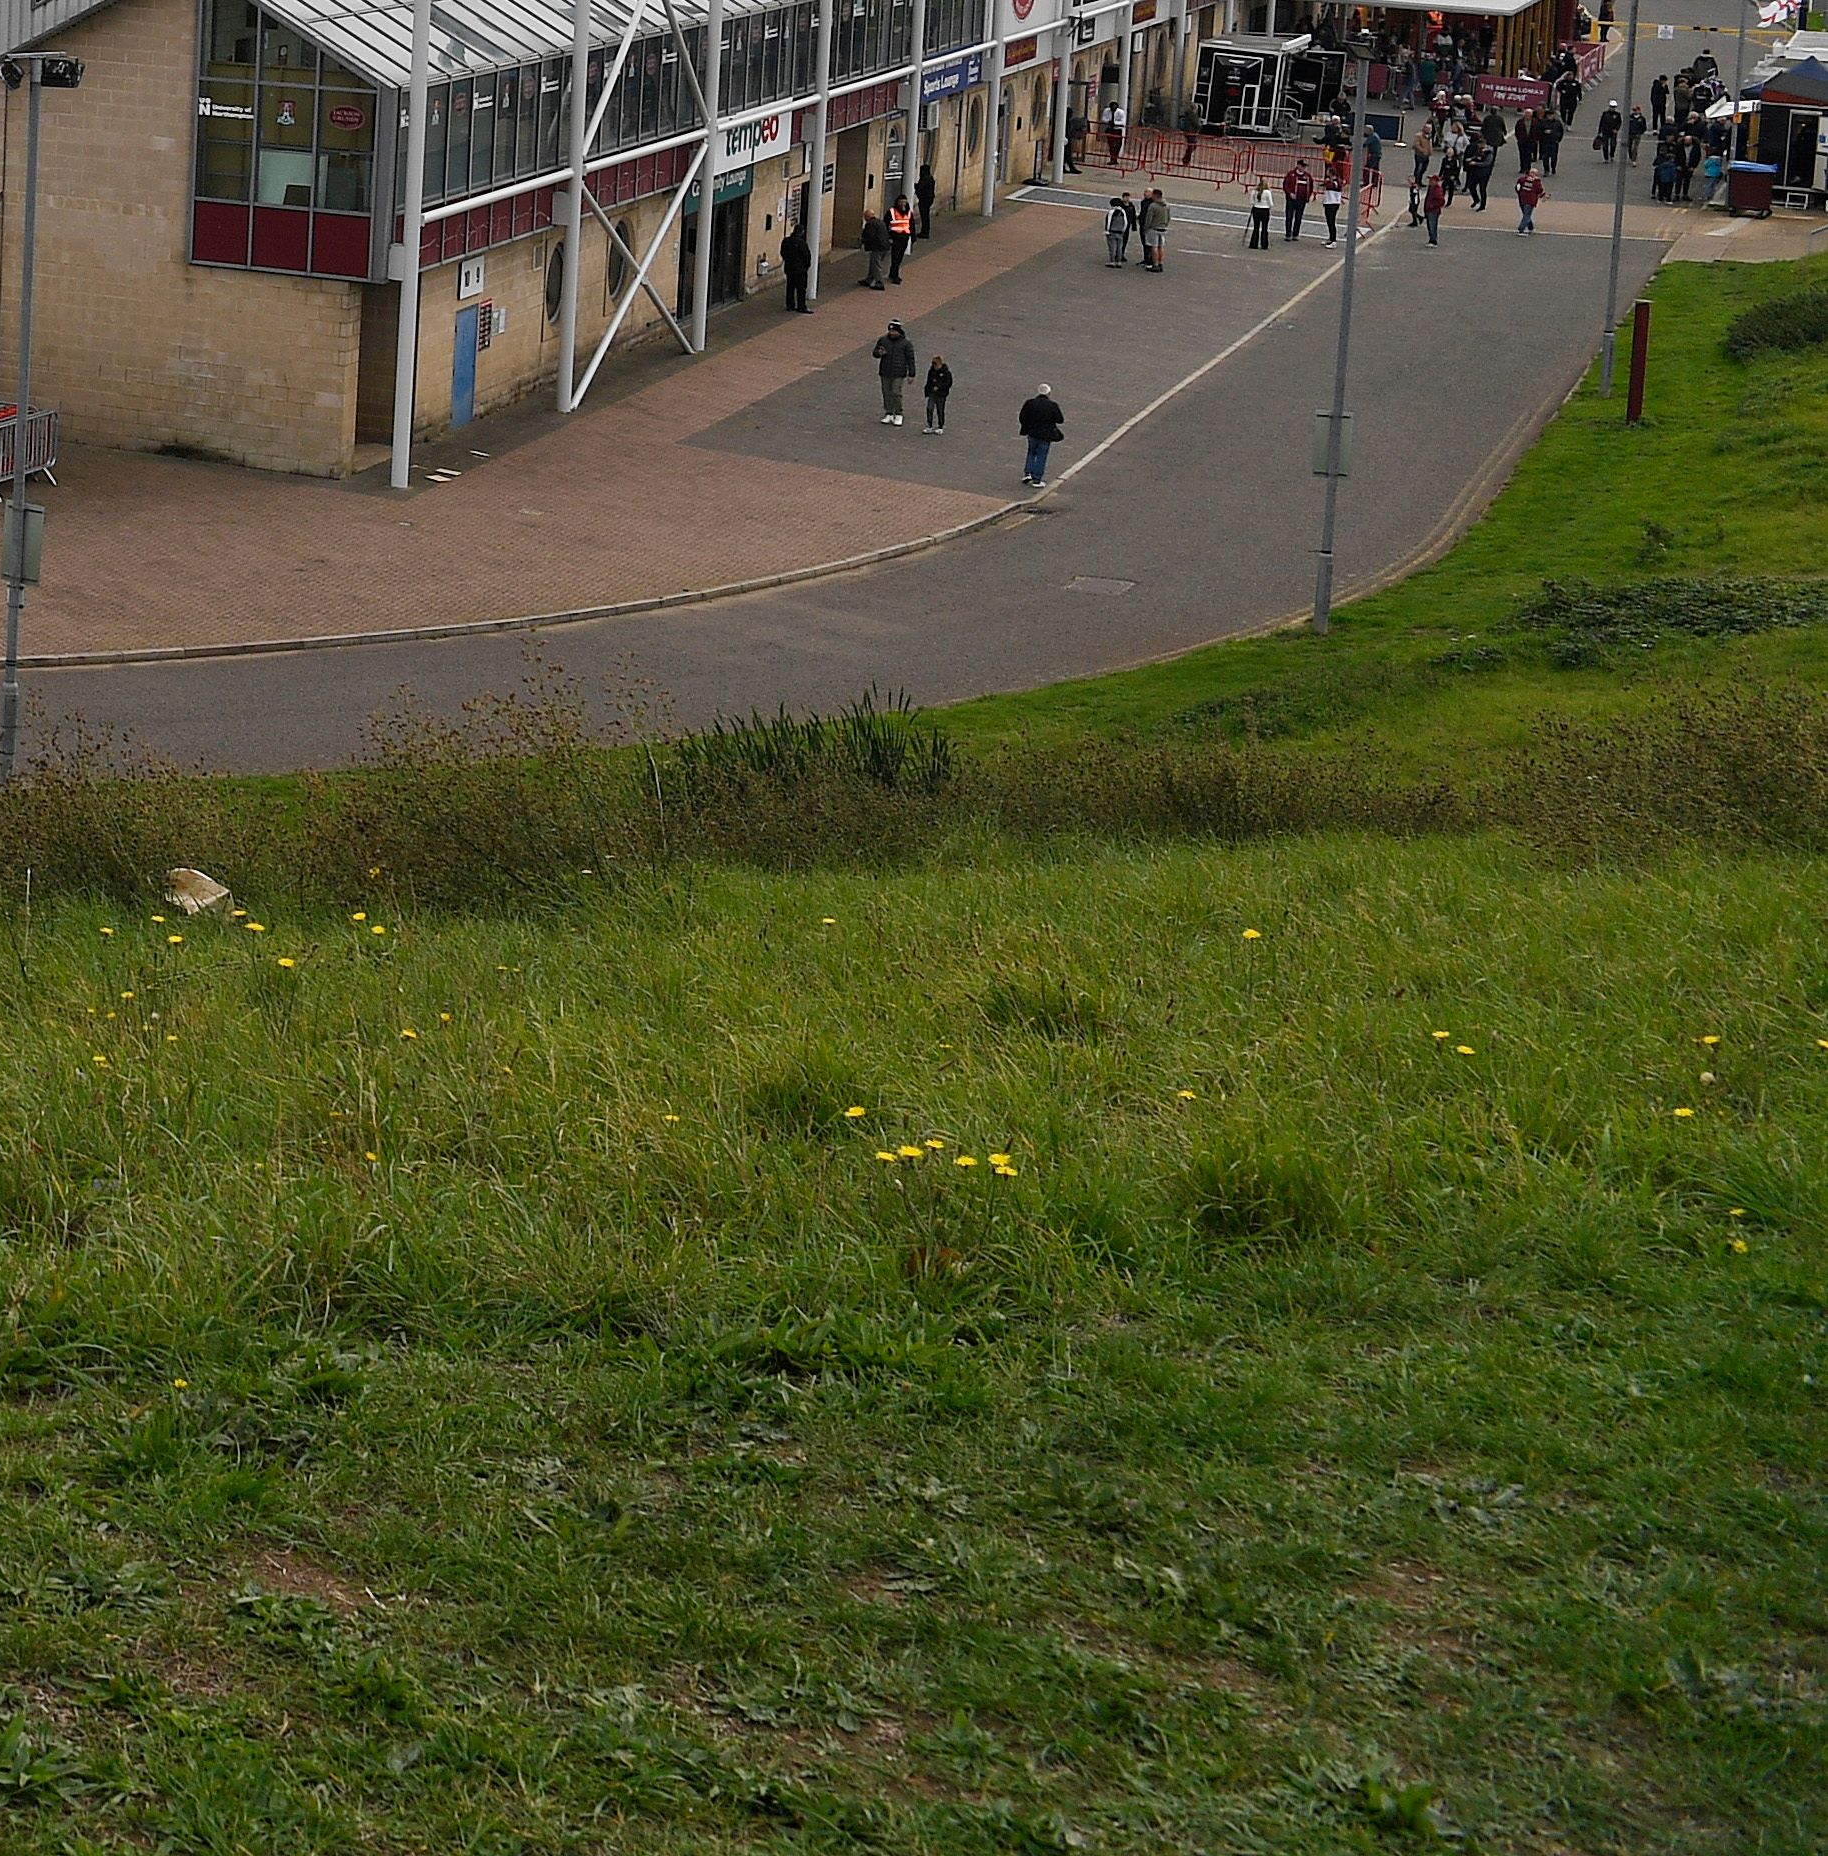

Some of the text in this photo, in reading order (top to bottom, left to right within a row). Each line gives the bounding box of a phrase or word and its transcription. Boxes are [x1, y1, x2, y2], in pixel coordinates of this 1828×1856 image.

[923, 76, 941, 97] Sports
[1481, 83, 1544, 95] THE BRIAN LOMAX
[212, 104, 244, 114] University
